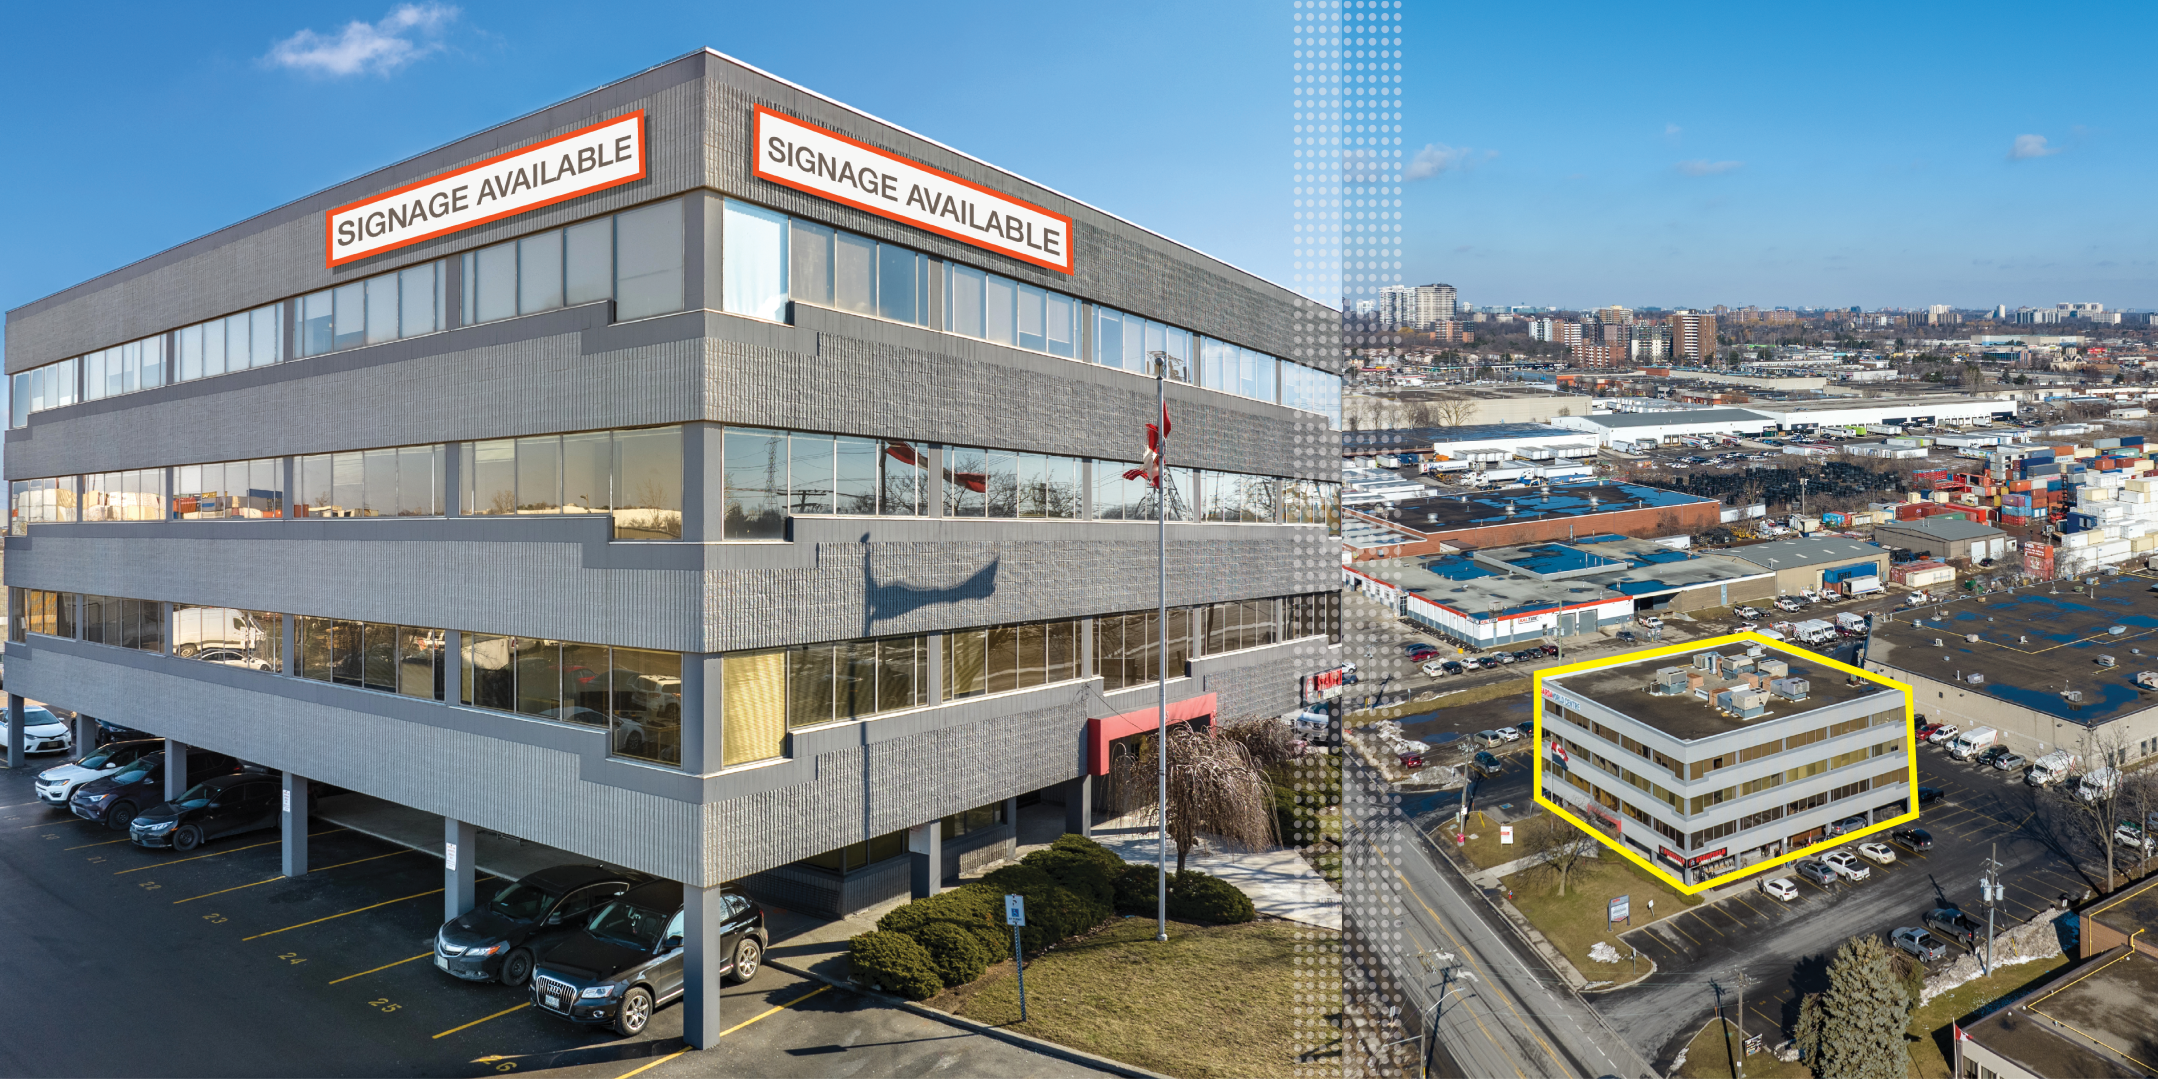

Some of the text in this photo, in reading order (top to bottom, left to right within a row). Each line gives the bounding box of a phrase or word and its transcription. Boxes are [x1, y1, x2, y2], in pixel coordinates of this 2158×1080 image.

[337, 134, 632, 248] SIGNAGE AVAILABLE
[767, 136, 1062, 257] SIGNAGE AVAILABLE
[1540, 686, 1565, 704] ARDAWORLD
[138, 881, 162, 891] 22
[202, 913, 229, 924] 23
[277, 952, 308, 965] 24
[367, 997, 403, 1013] 25
